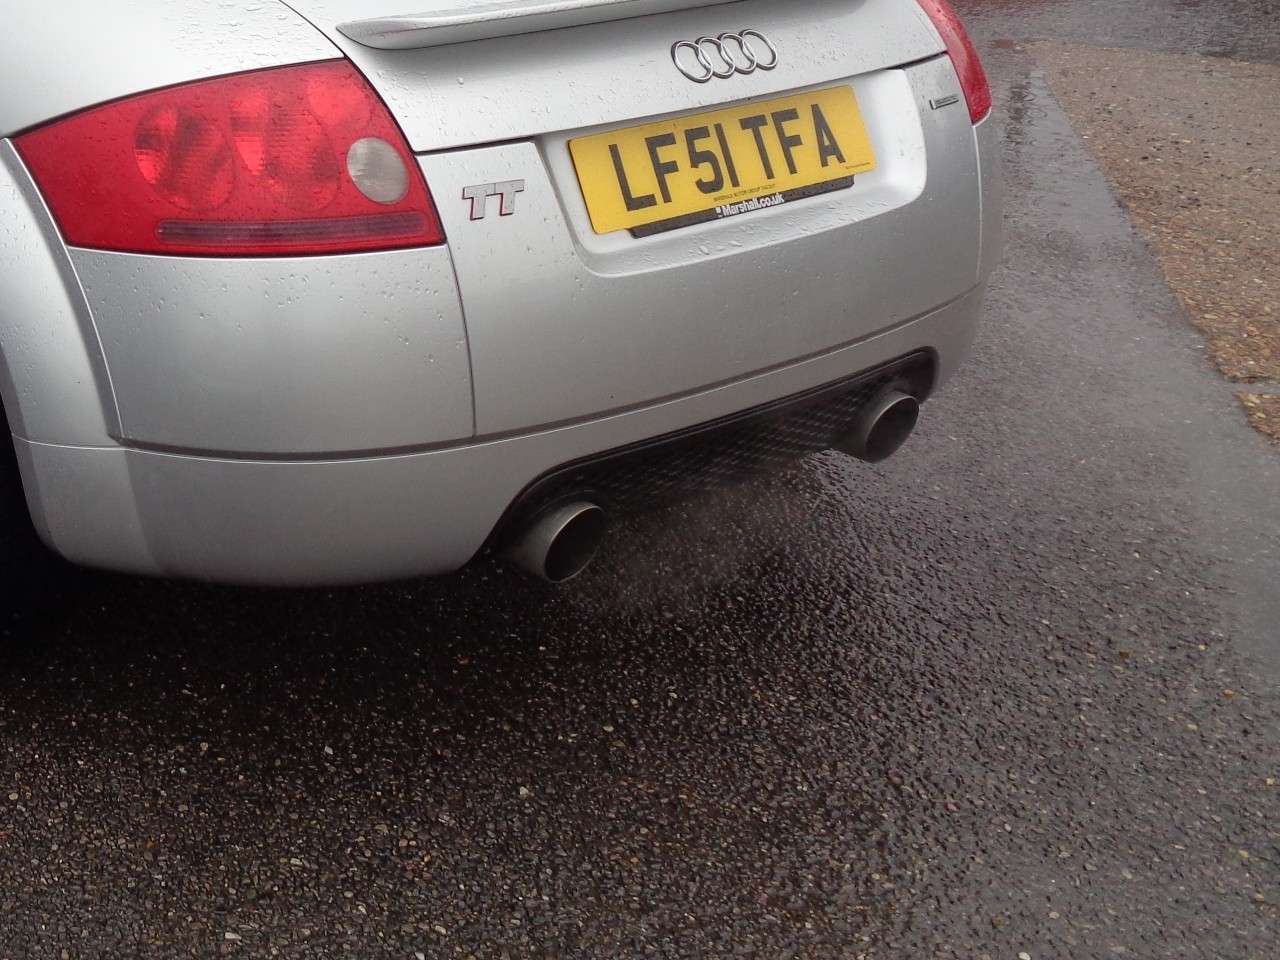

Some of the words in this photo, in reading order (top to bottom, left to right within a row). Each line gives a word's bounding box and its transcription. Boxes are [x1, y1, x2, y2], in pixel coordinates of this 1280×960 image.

[607, 123, 741, 211] LF51
[739, 103, 846, 180] TFA
[462, 179, 525, 220] TT
[721, 192, 785, 216] Marshall.co.uk
